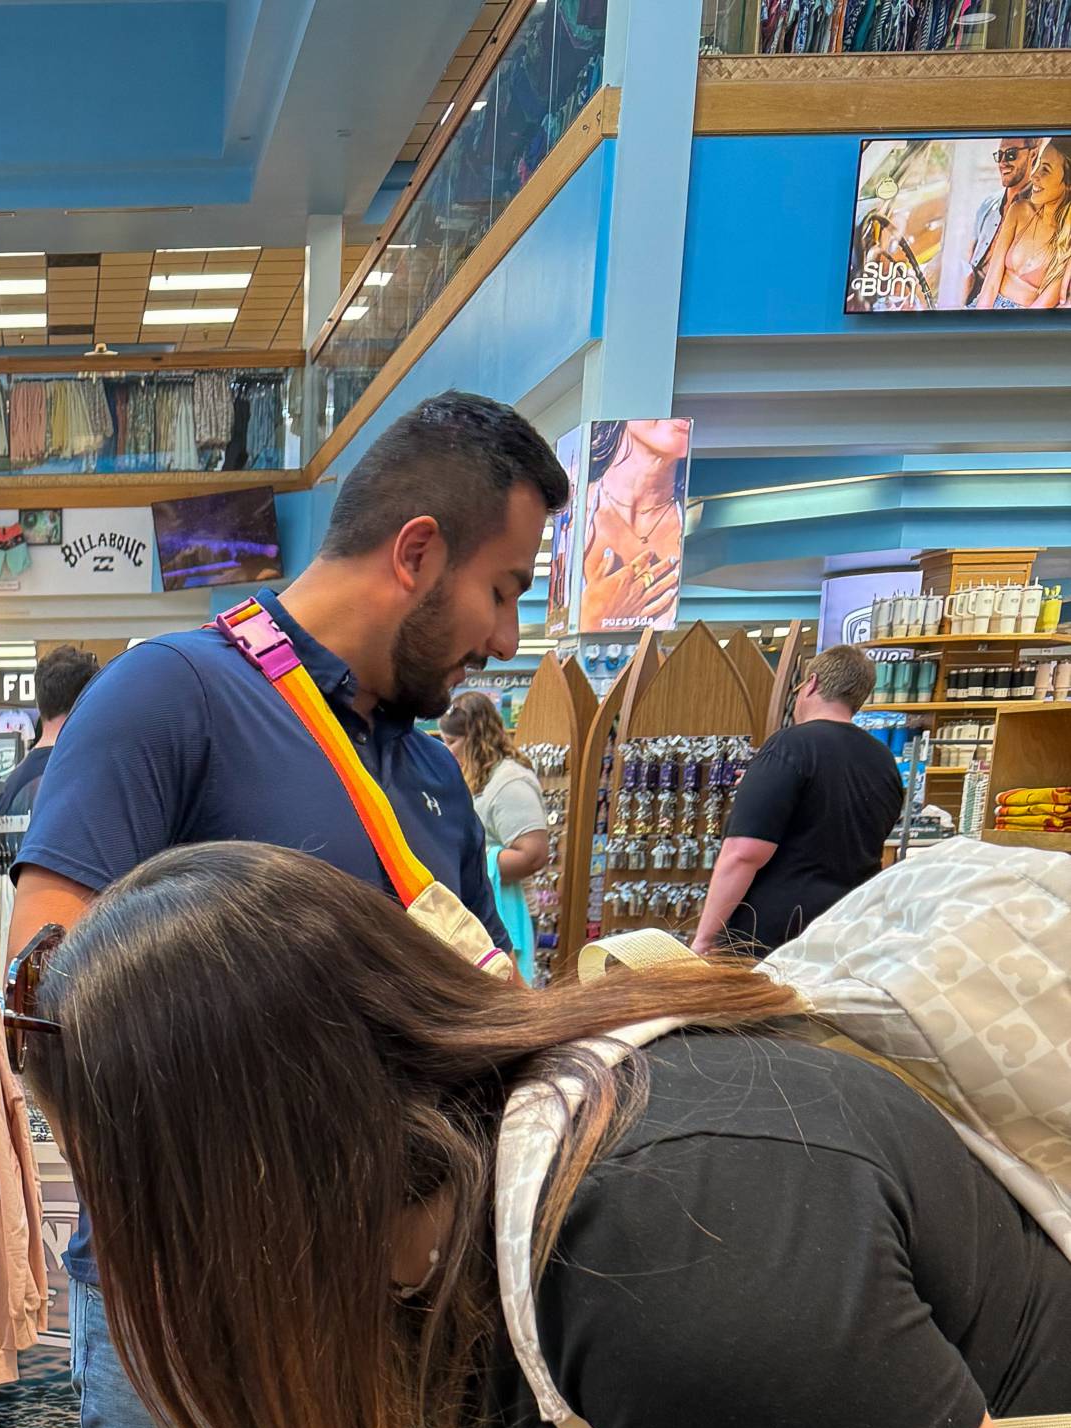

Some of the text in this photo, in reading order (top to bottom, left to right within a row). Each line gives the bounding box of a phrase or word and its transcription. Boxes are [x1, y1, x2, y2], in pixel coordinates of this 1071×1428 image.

[862, 261, 907, 280] SUN
[851, 277, 916, 307] BUM
[61, 532, 146, 568] BILLABONG
[3, 674, 35, 701] FO
